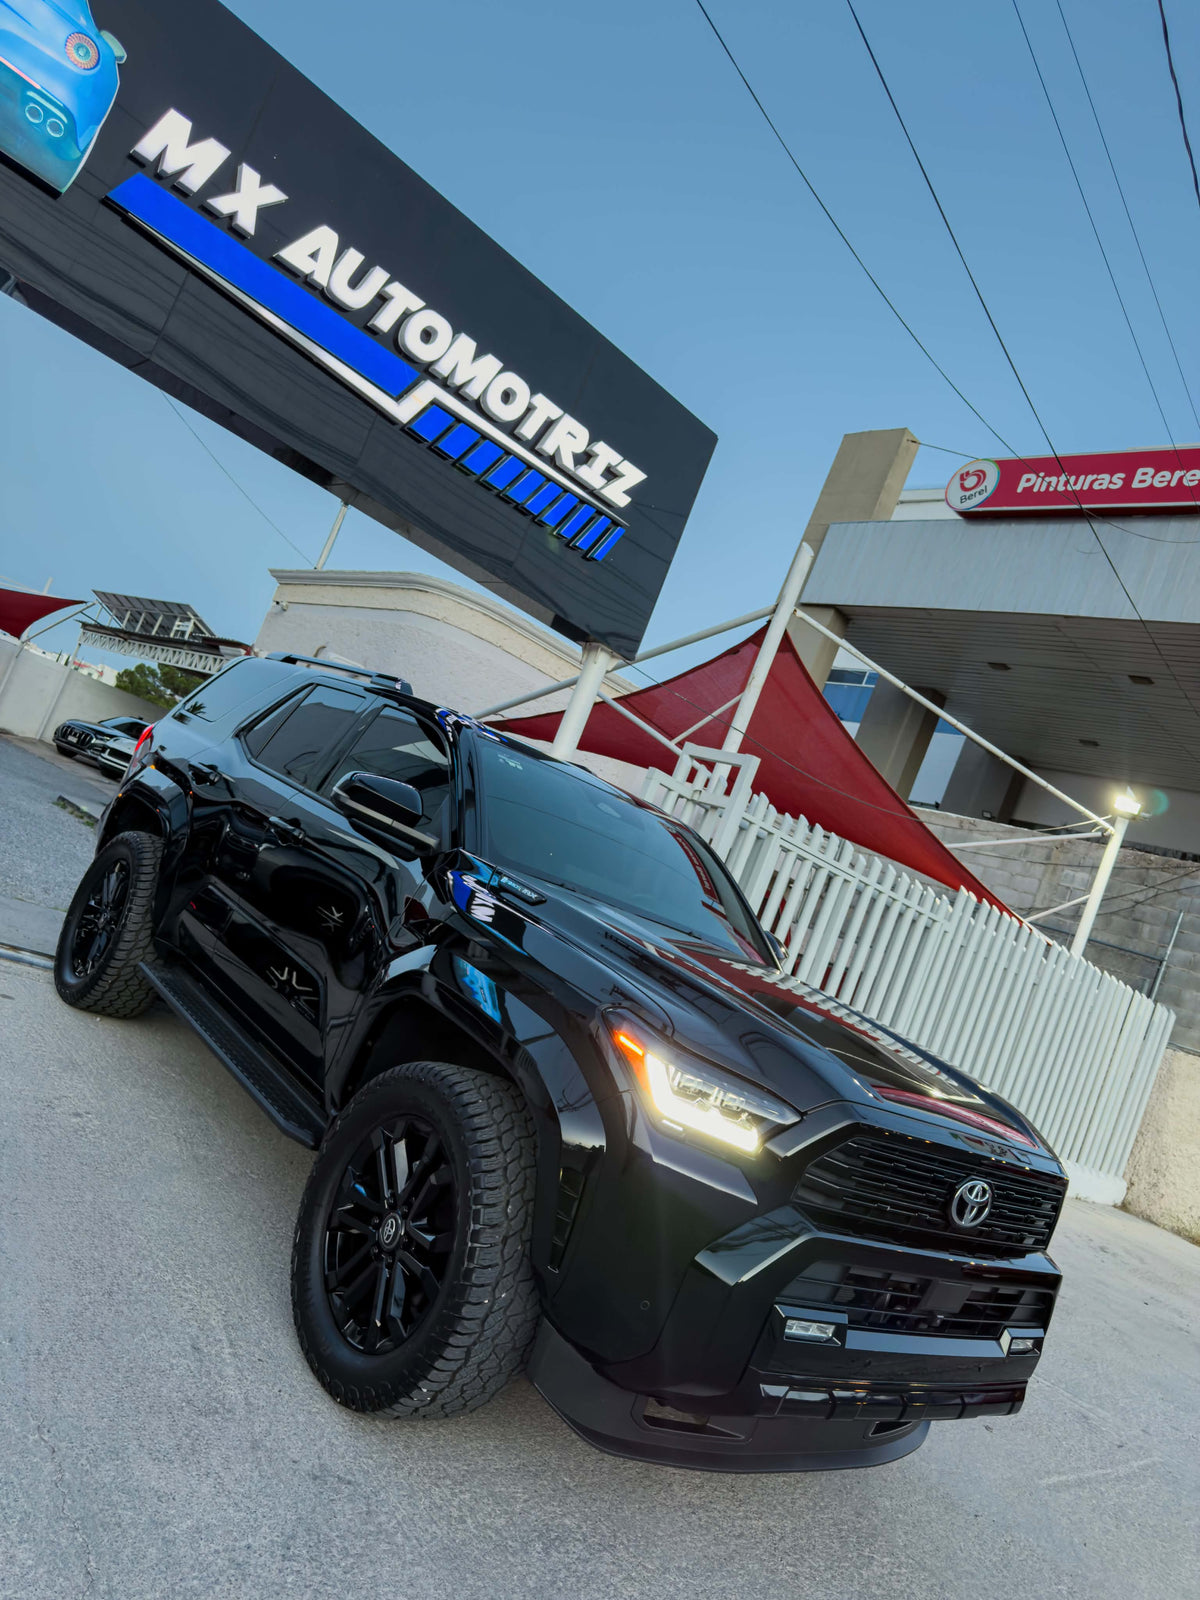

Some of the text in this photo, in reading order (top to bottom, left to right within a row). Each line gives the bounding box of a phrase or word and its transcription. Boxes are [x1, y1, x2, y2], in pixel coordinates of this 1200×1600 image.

[129, 107, 648, 509] MX AUTOMOTRIZ
[1016, 472, 1126, 493] Pinturas
[959, 485, 988, 505] Berel
